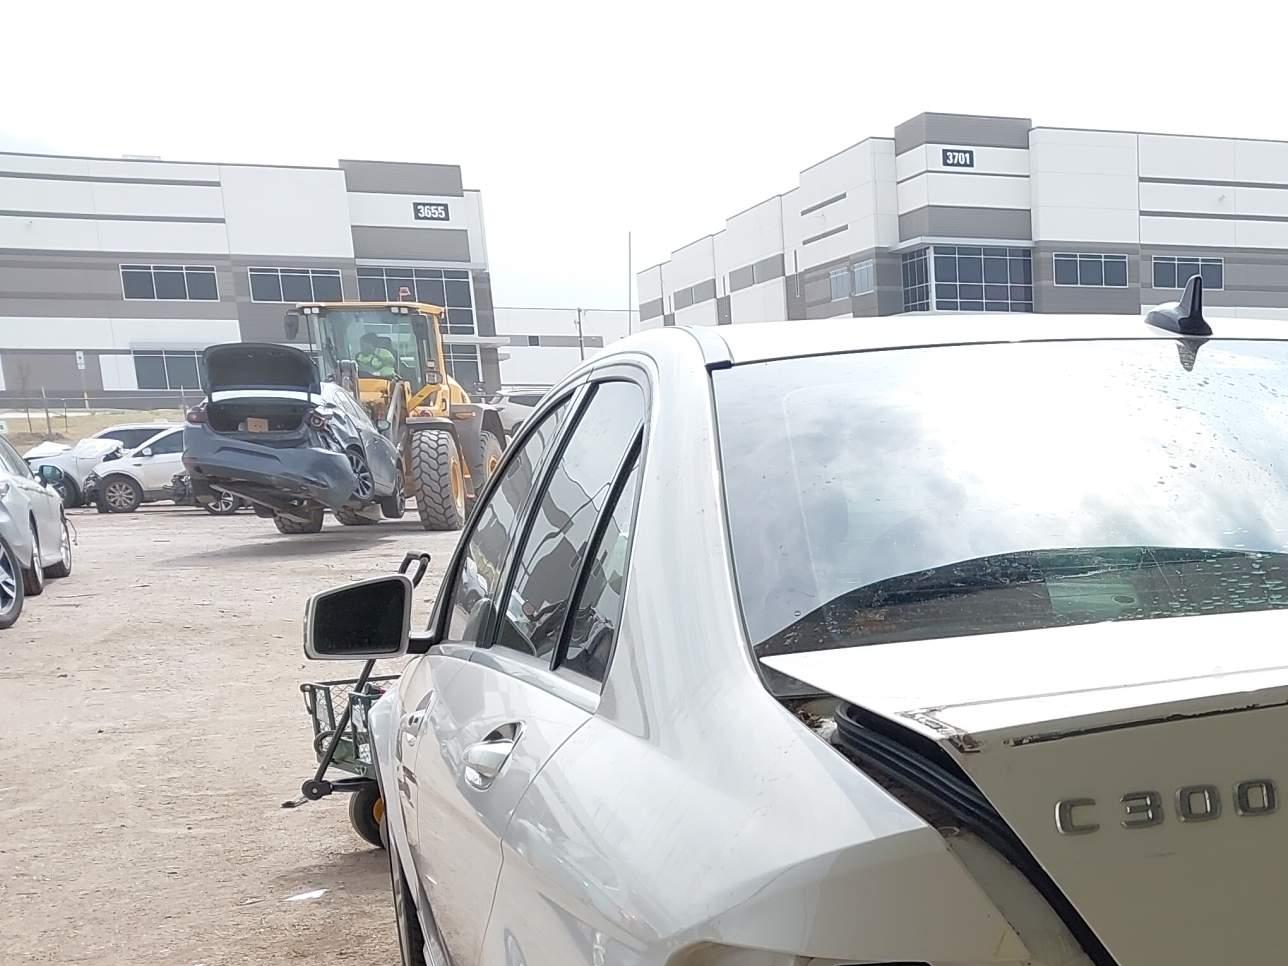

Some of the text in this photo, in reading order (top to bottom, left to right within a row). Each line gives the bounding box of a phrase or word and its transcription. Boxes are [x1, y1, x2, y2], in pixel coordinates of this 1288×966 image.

[946, 151, 970, 165] 3701
[417, 205, 446, 218] 3655
[1054, 778, 1281, 836] C 300
